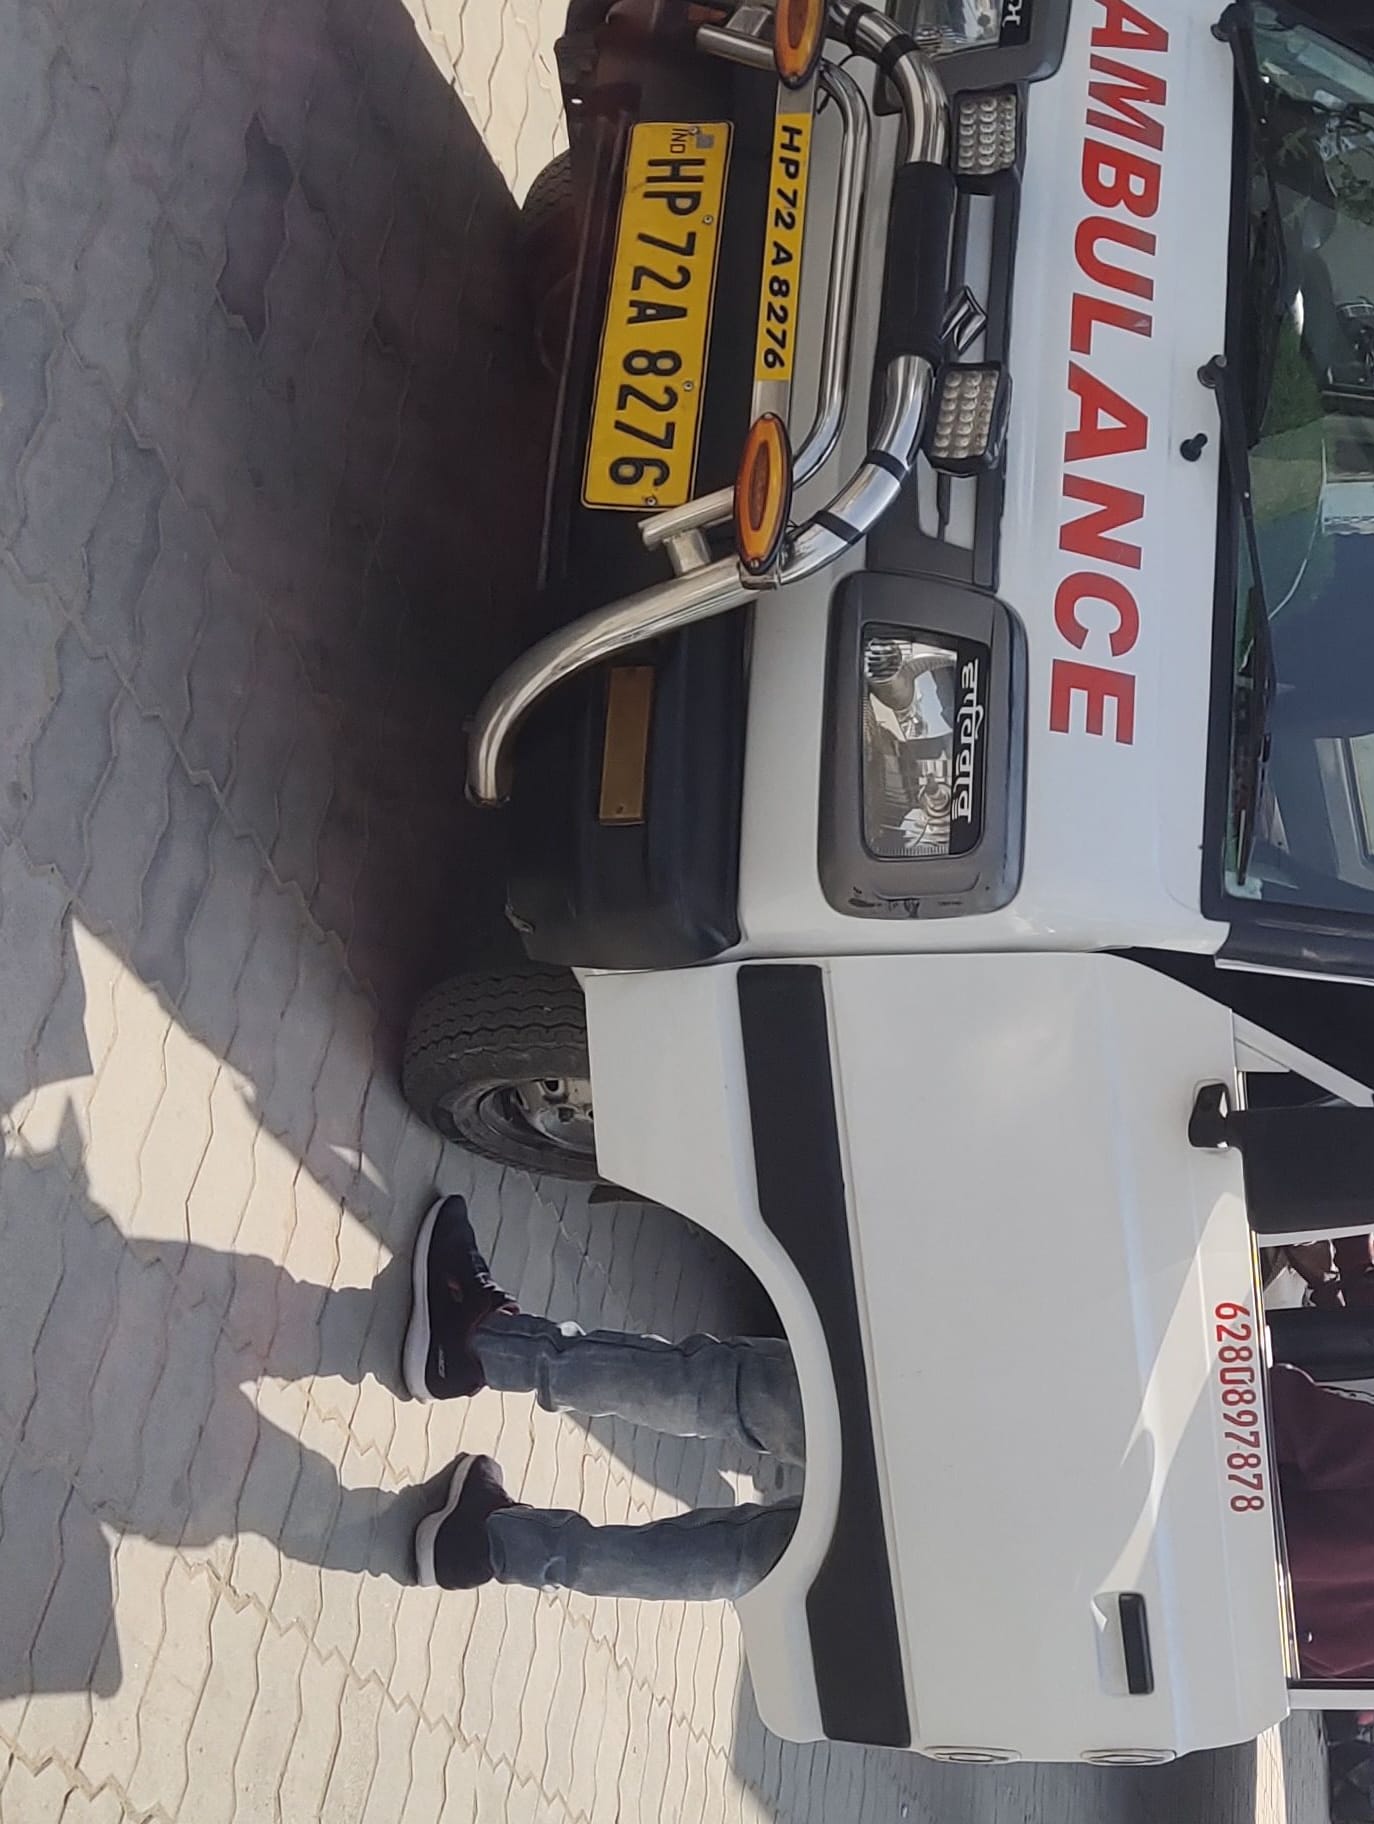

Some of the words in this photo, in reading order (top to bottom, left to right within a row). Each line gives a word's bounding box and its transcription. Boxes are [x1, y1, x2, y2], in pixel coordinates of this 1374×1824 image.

[643, 157, 706, 217] HP
[669, 127, 691, 154] IND
[763, 275, 790, 370] 8276
[1048, 0, 1170, 747] AMBULANCE
[609, 348, 683, 488] 8276
[1214, 1302, 1265, 1513] 6280897878
